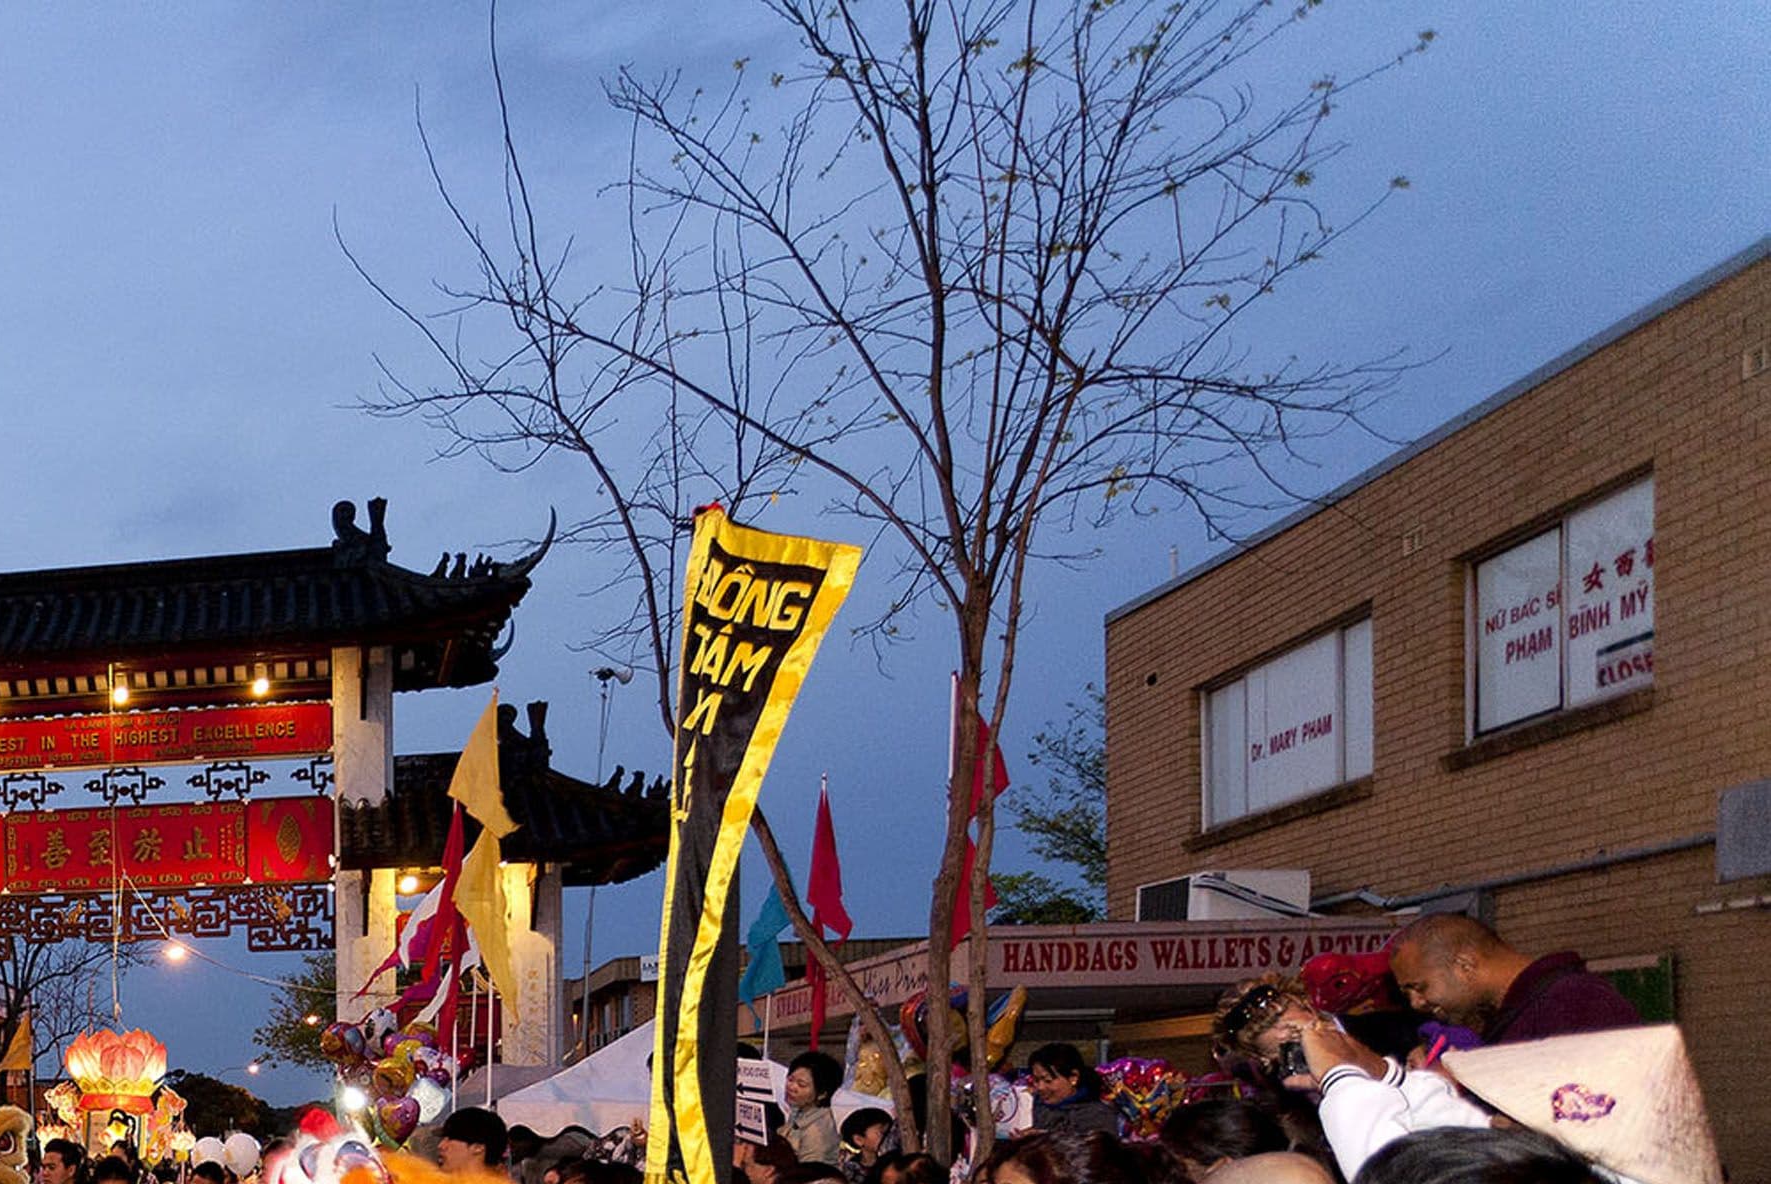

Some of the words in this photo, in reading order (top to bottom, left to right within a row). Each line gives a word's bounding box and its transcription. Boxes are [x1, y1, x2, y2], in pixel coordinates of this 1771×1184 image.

[40, 735, 56, 750] IN
[71, 732, 100, 748] THE
[113, 728, 180, 746] HIGHEST
[193, 720, 297, 741] EXCELLENCE
[1002, 940, 1139, 974] HANDBAGS
[1150, 936, 1271, 970] WALLETS
[1277, 934, 1295, 968] &
